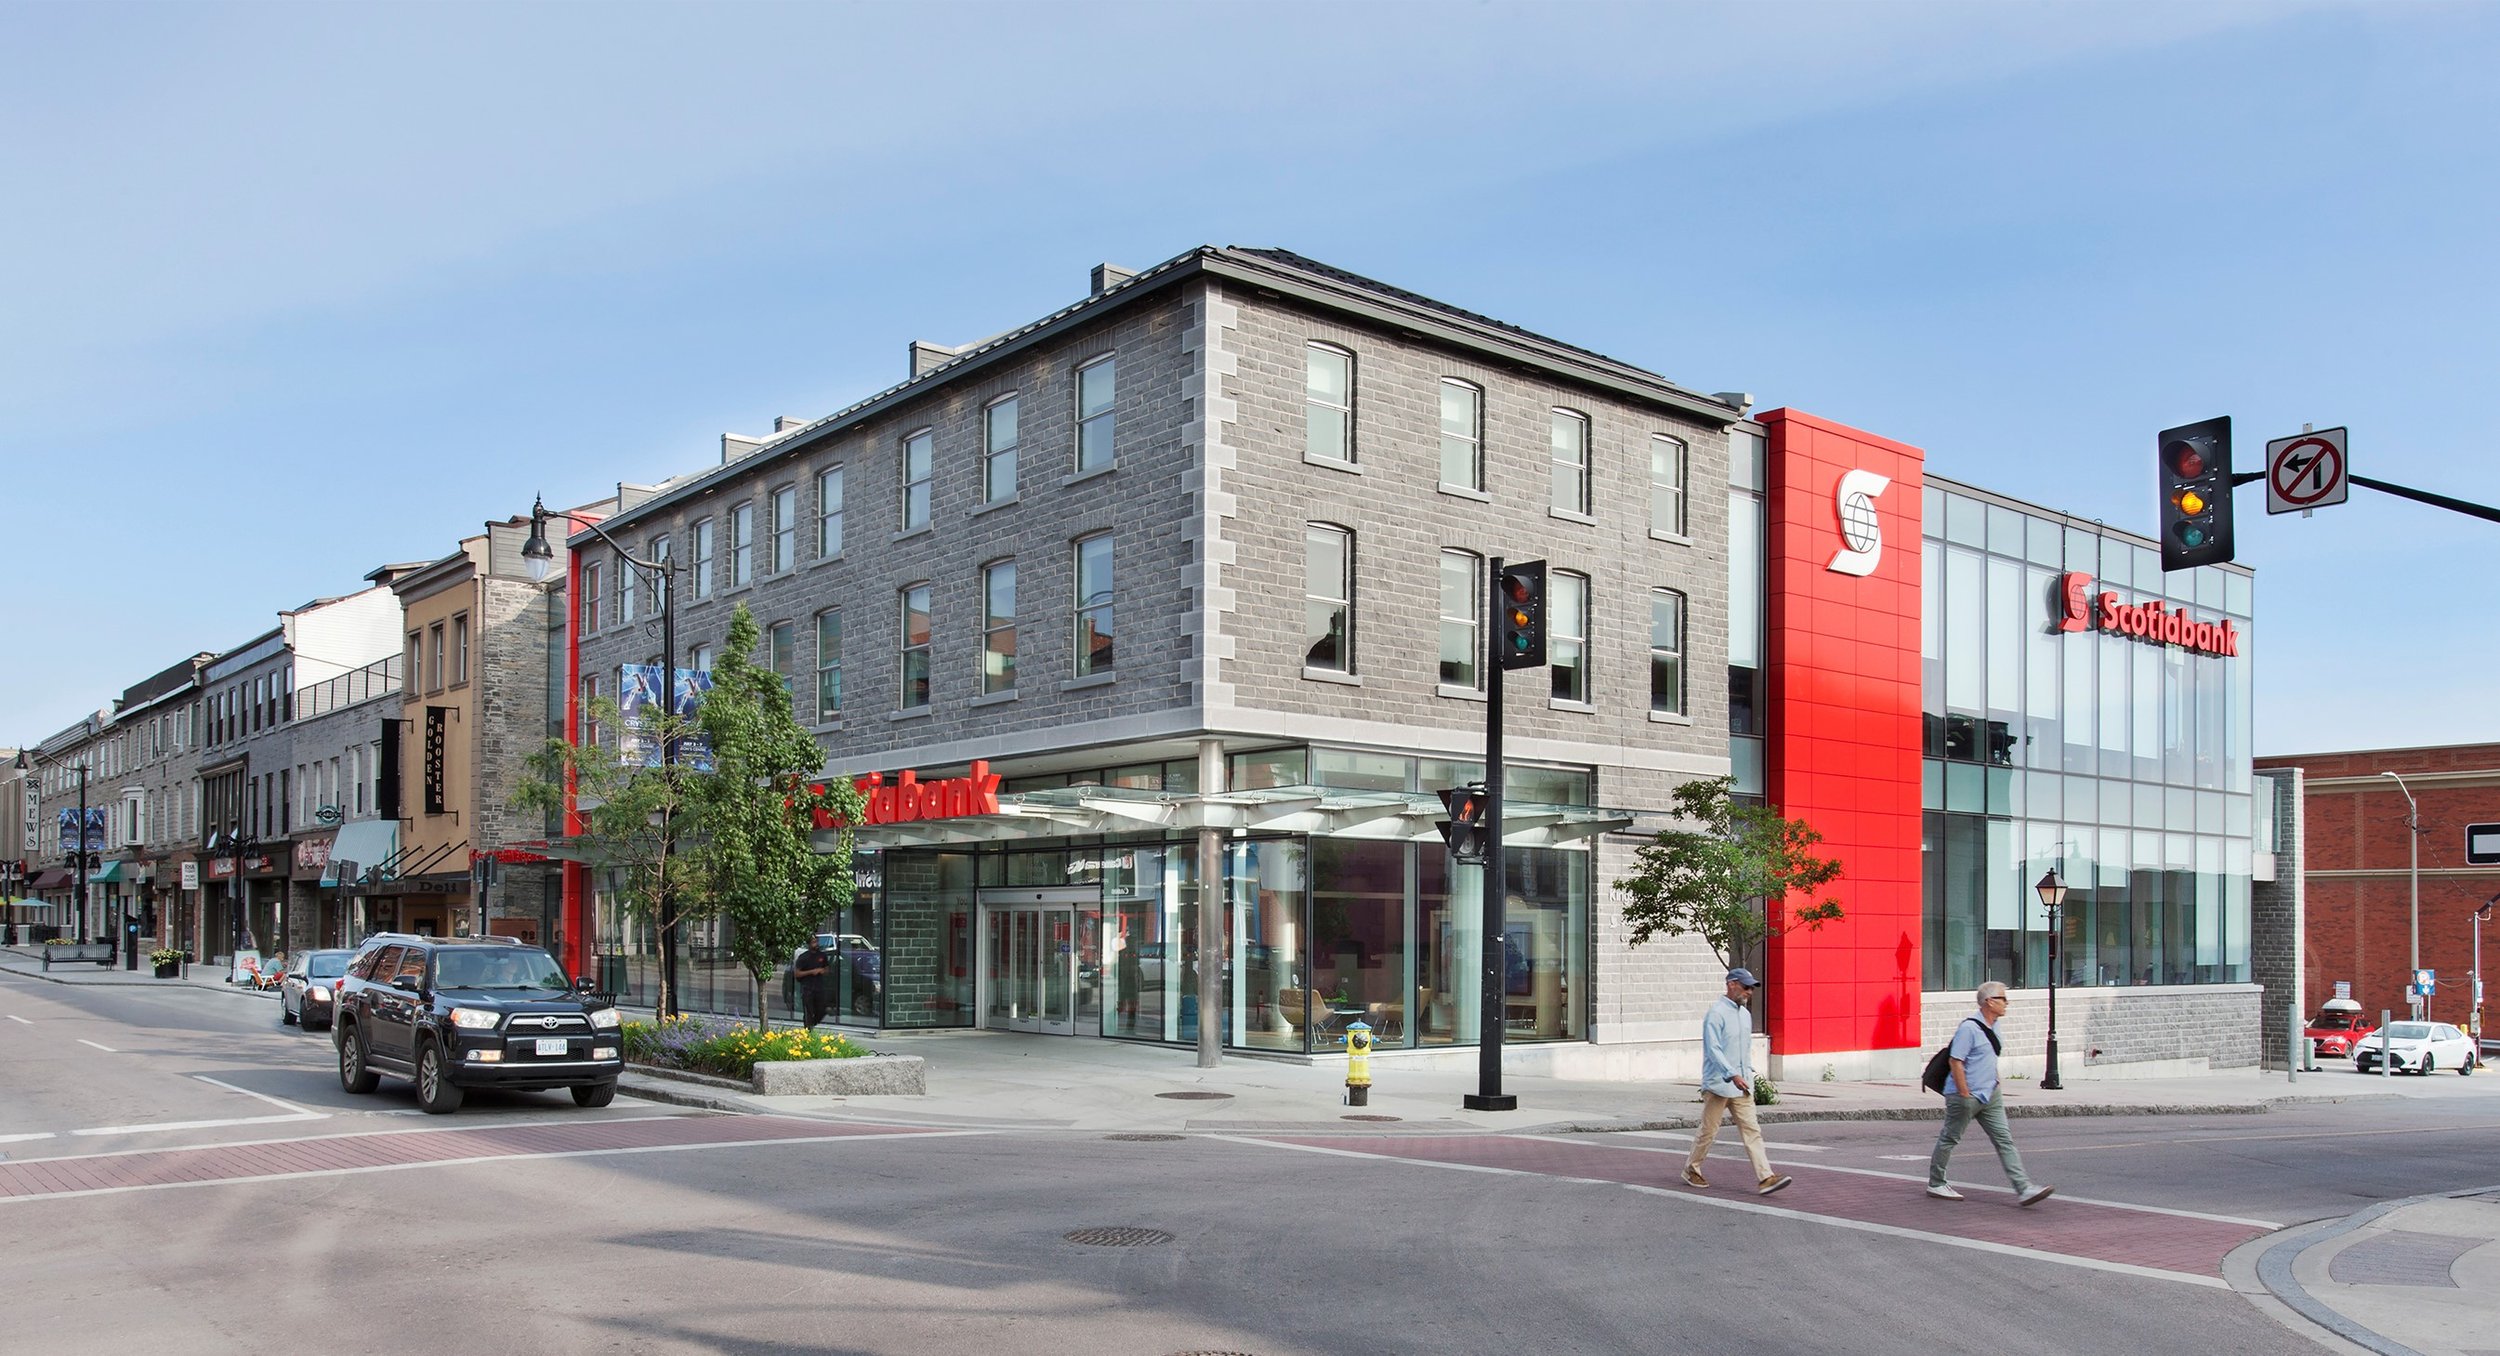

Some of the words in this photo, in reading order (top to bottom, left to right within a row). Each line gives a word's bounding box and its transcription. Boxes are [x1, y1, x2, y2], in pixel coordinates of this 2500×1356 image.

[2098, 591, 2239, 657] Scotiabank
[426, 715, 435, 785] GOLDEN
[435, 723, 443, 804] ROOSTER
[25, 794, 39, 847] MEWS
[419, 881, 457, 892] Deli
